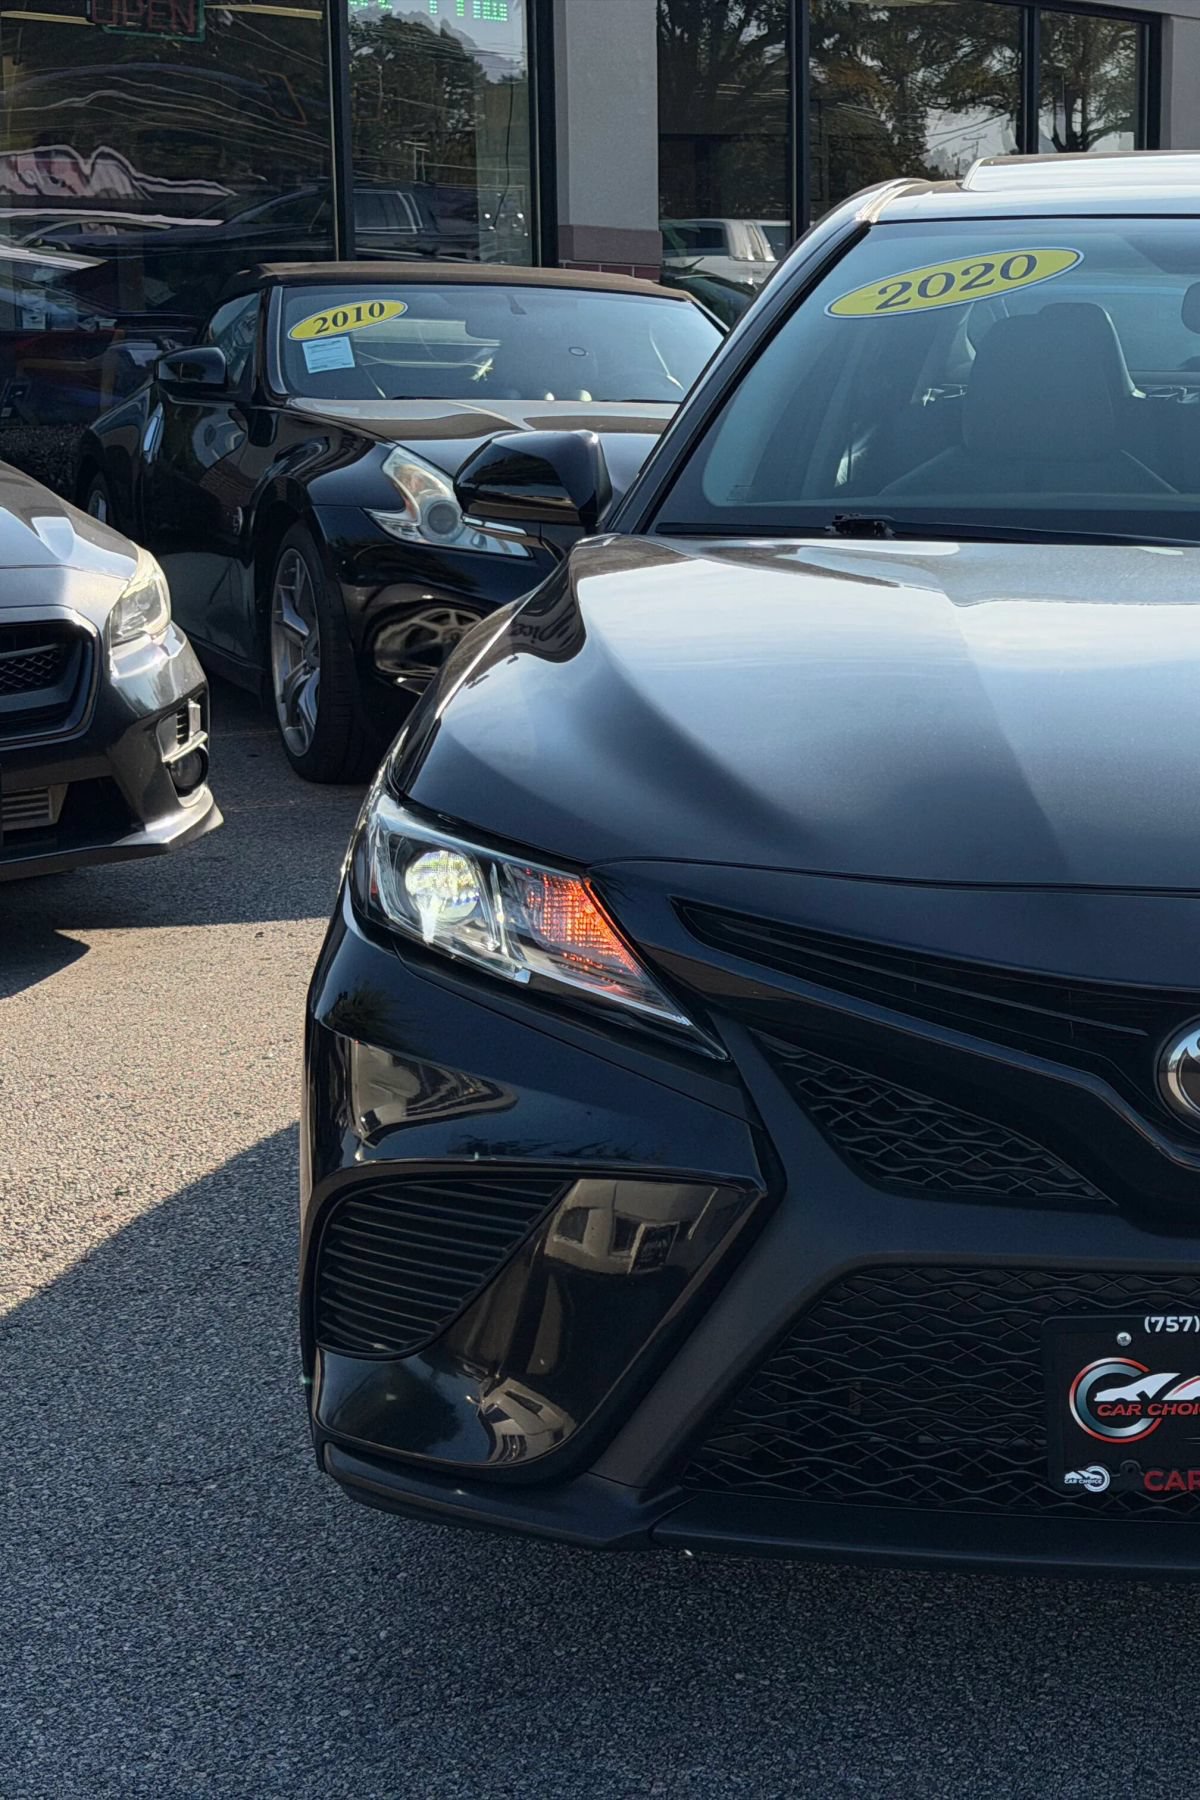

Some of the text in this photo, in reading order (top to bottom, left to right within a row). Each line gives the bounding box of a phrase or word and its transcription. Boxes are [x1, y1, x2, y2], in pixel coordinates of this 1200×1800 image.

[875, 254, 1038, 311] 2020
[313, 302, 385, 335] 2010
[1144, 1315, 1200, 1333] (757)
[1097, 1404, 1142, 1417] CAR
